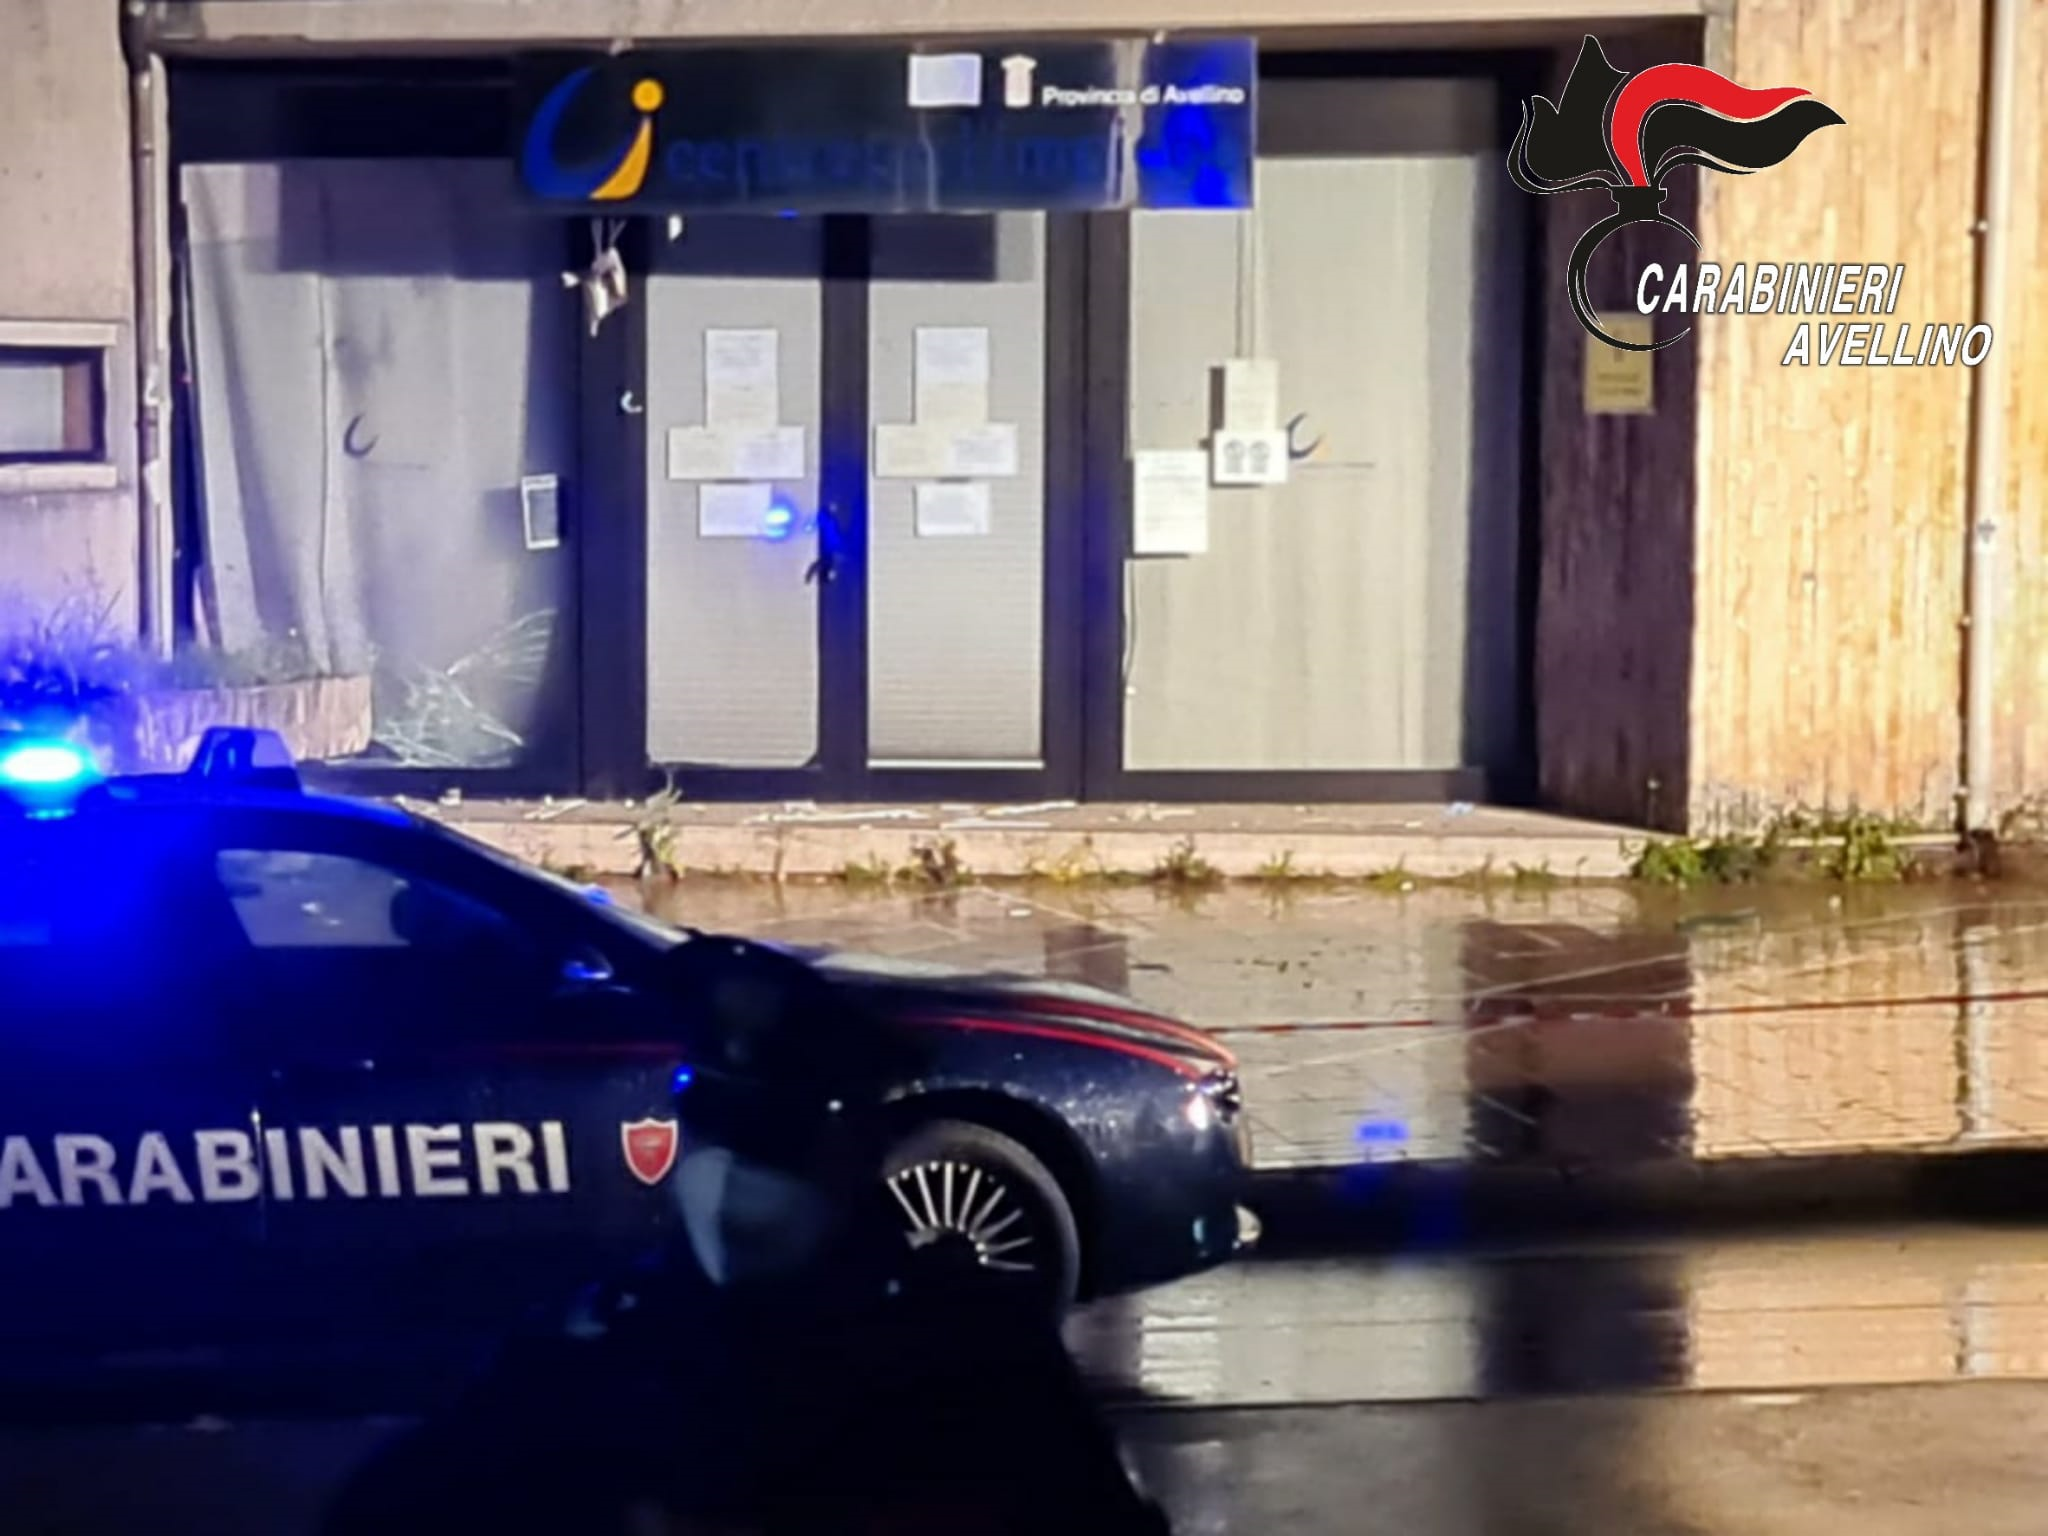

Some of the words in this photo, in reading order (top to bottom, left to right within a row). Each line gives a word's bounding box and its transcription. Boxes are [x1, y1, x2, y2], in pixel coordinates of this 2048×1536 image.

[1041, 85, 1136, 106] Provincia
[1139, 86, 1160, 104] di
[0, 1120, 571, 1208] ARABINIERI
